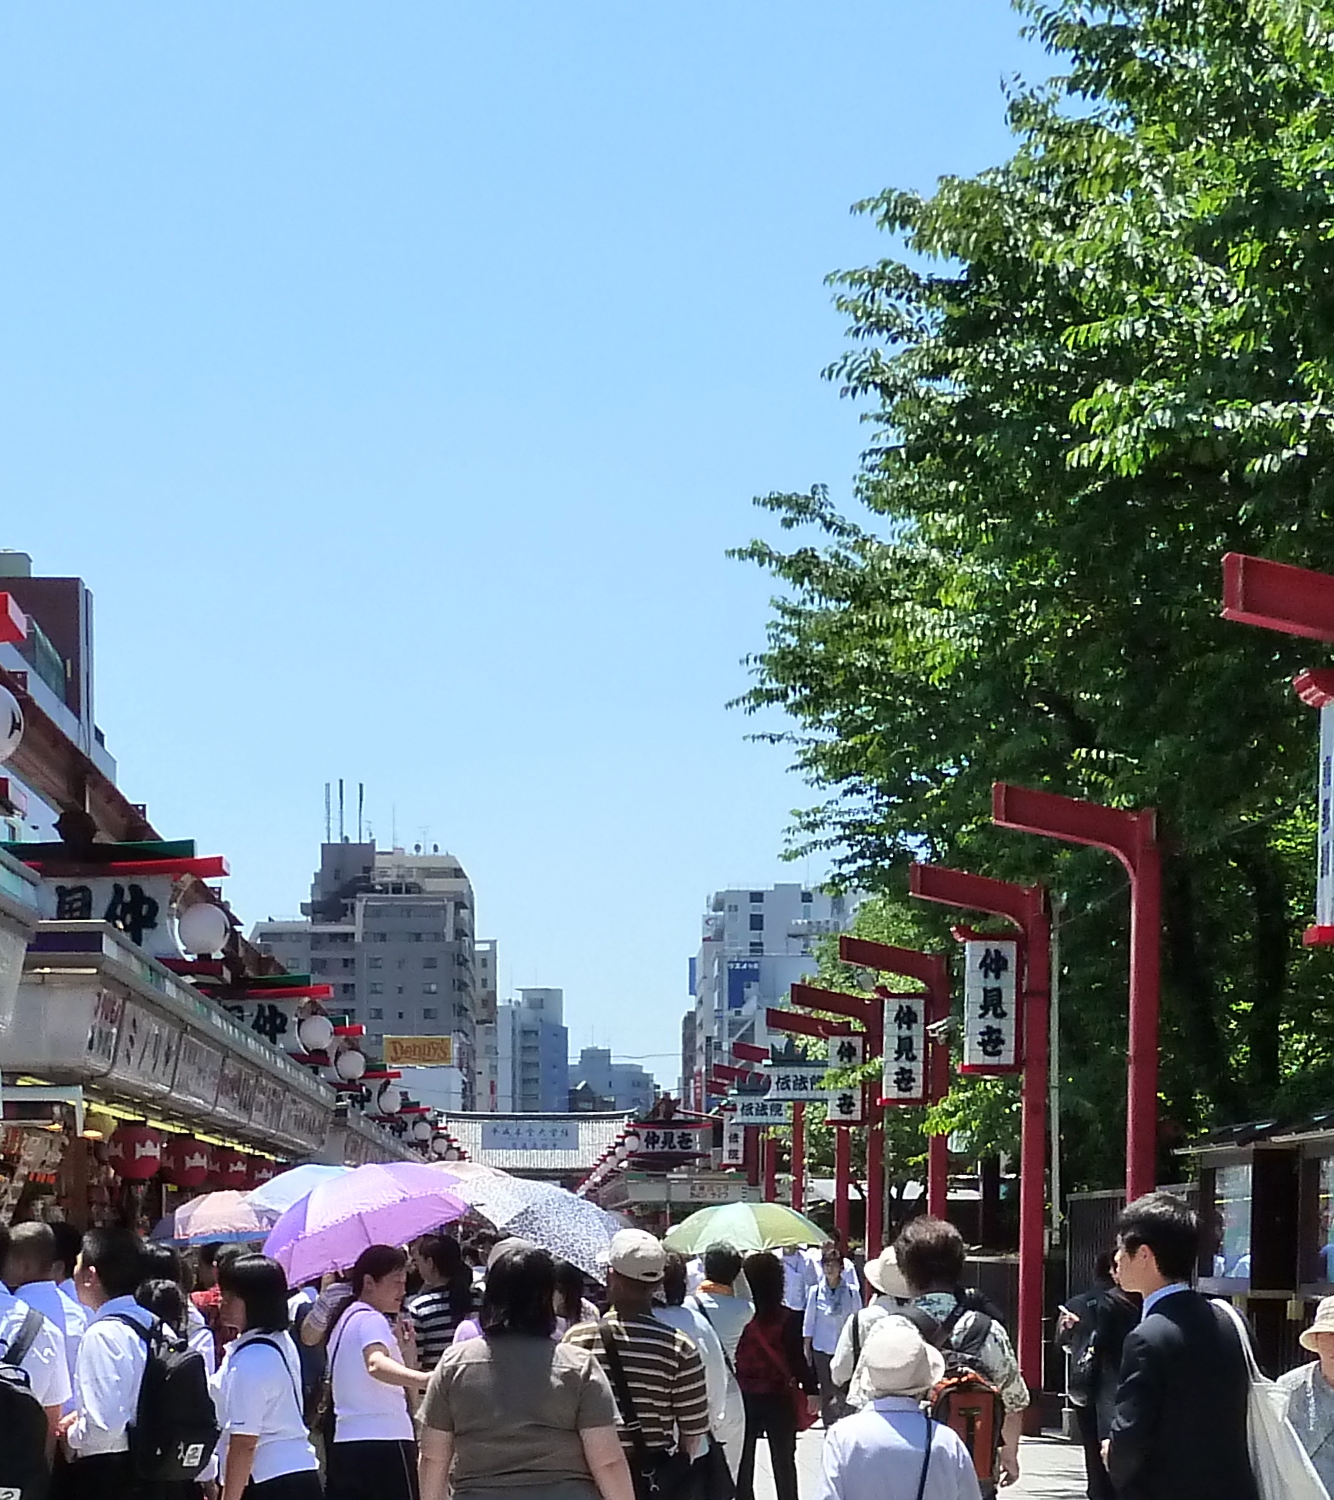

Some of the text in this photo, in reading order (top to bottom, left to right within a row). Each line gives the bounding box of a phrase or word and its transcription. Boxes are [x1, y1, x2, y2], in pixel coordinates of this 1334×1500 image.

[978, 947, 1009, 1058] 仲見世
[388, 1040, 448, 1063] Denny's
[836, 1040, 856, 1115] 仲世
[893, 1005, 918, 1093] 仲見世
[644, 1130, 693, 1150] 仲見世
